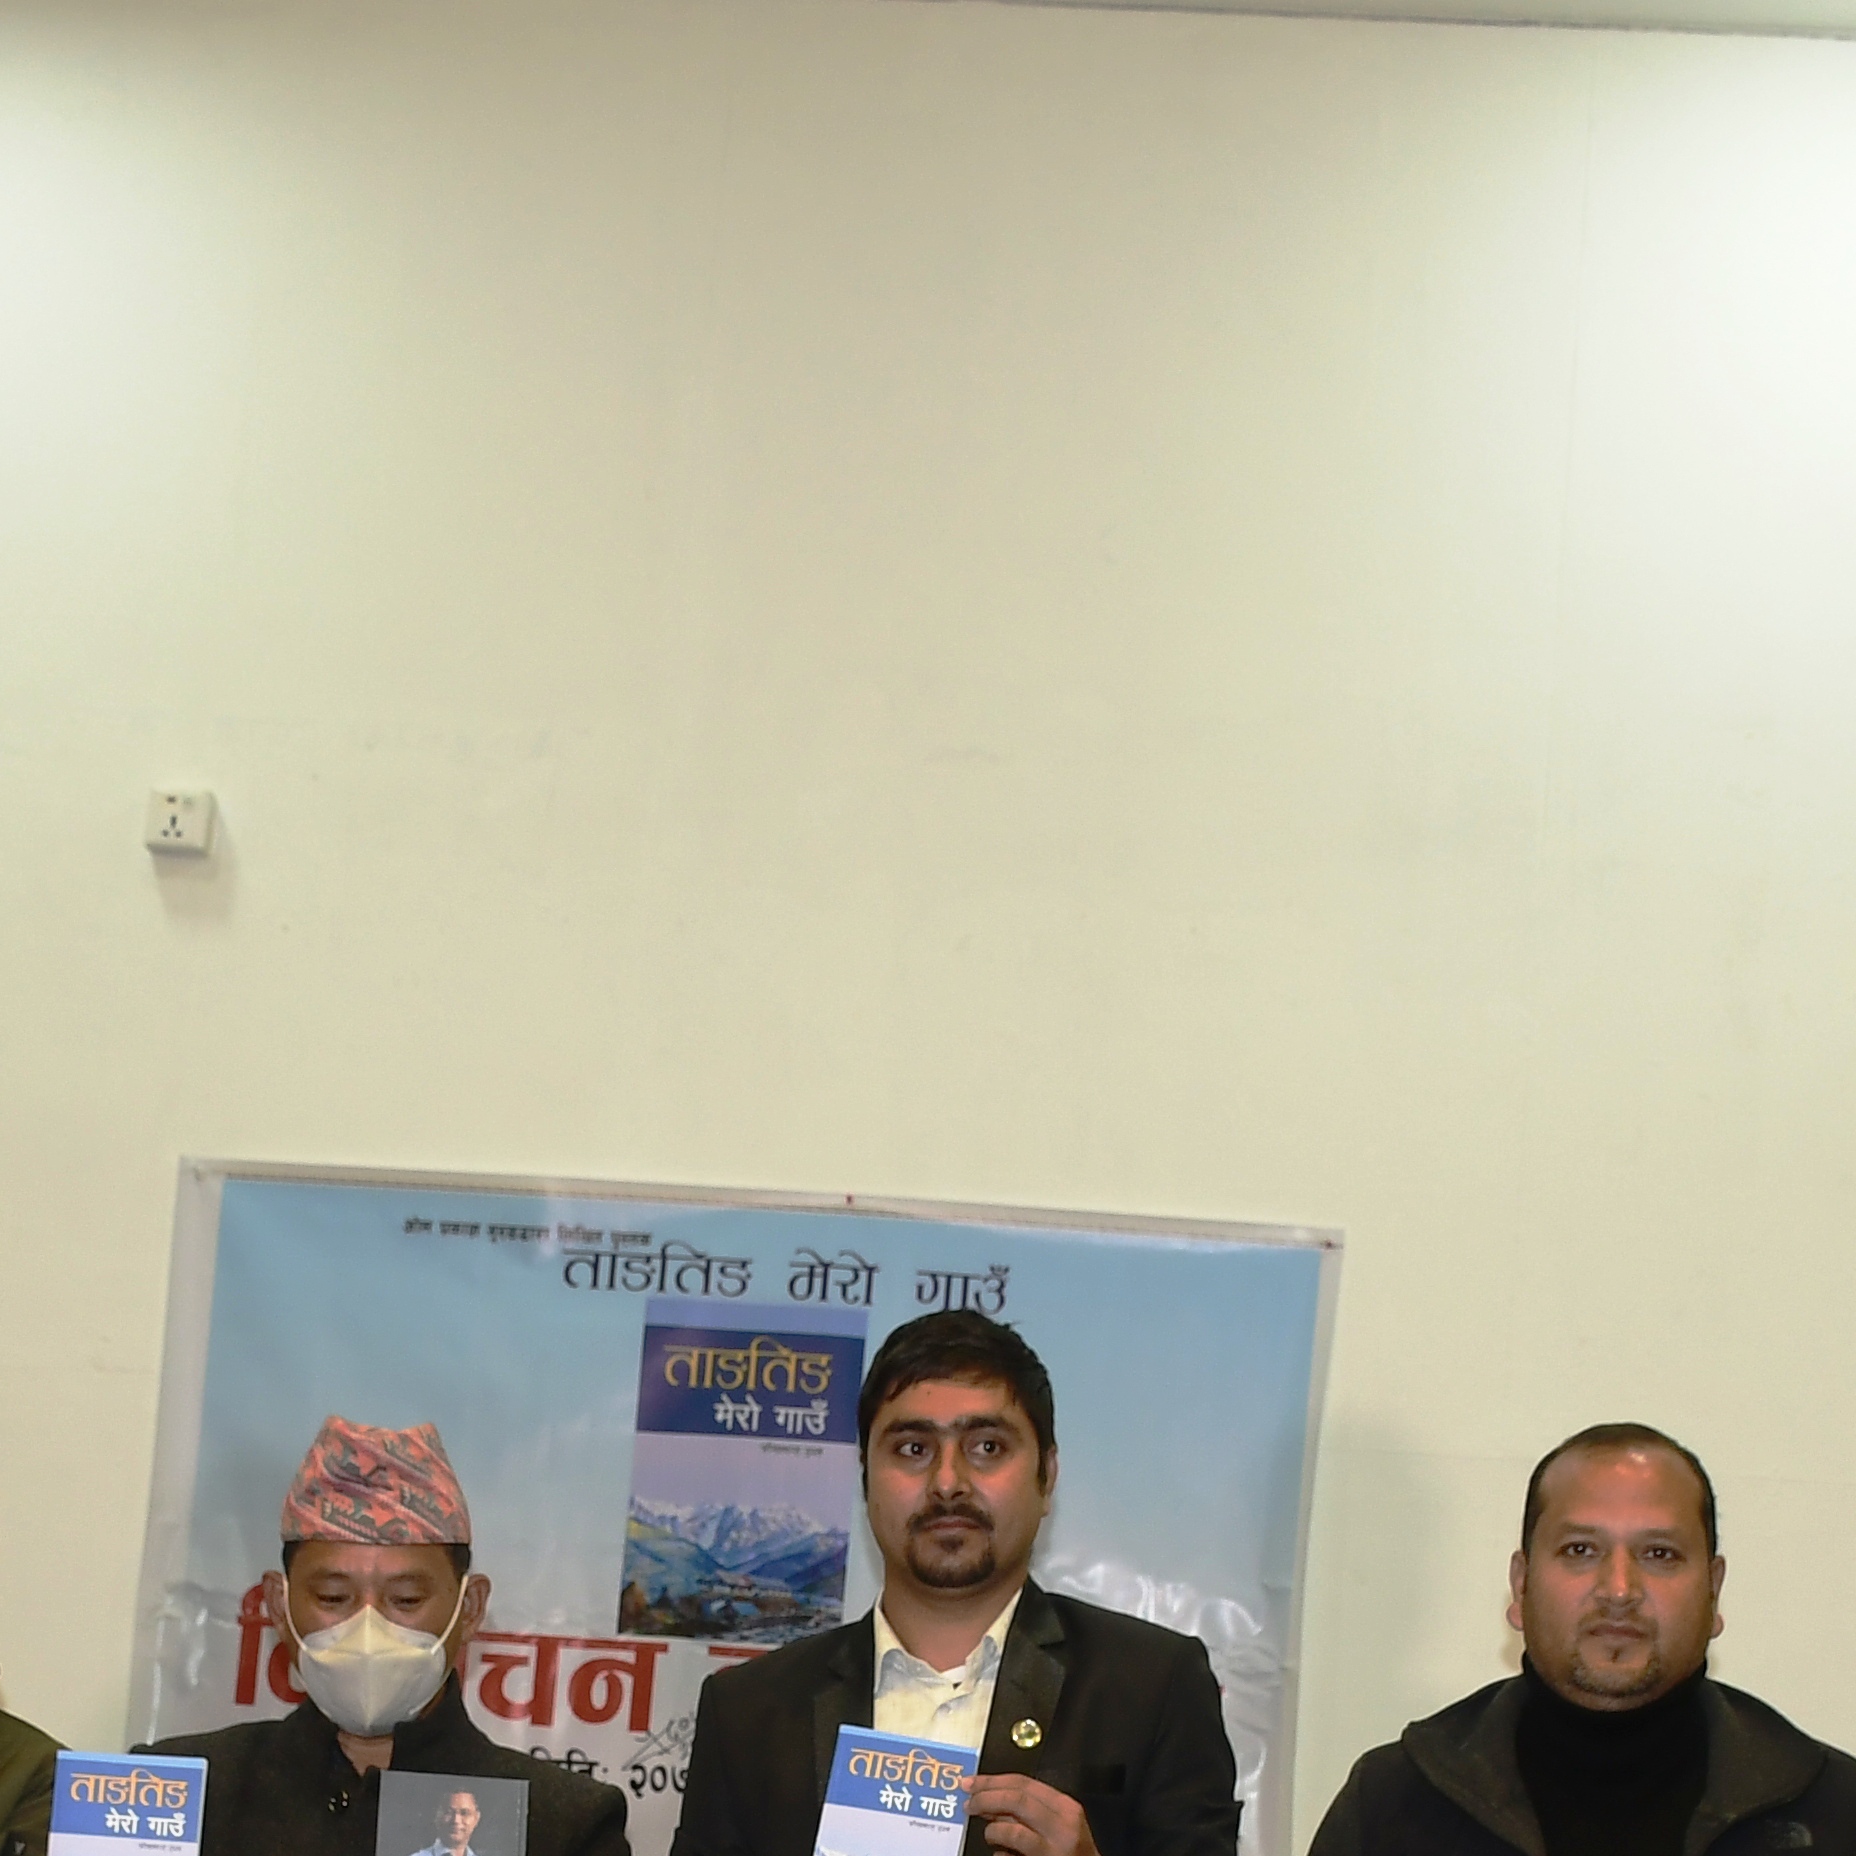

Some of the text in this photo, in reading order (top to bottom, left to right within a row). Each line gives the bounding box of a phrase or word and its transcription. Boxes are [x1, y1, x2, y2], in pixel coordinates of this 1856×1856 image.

[561, 1238, 1012, 1318] ताङतिङ मेरो गाउँ
[663, 1334, 834, 1396] ताङतिङ
[713, 1394, 830, 1436] मेरो गाउँ
[69, 1767, 189, 1810] ताङतिङ
[848, 1747, 964, 1791] ताङतिङ
[104, 1807, 186, 1838] मेरो गाउँ
[879, 1784, 957, 1819] मेरो गाउँ
